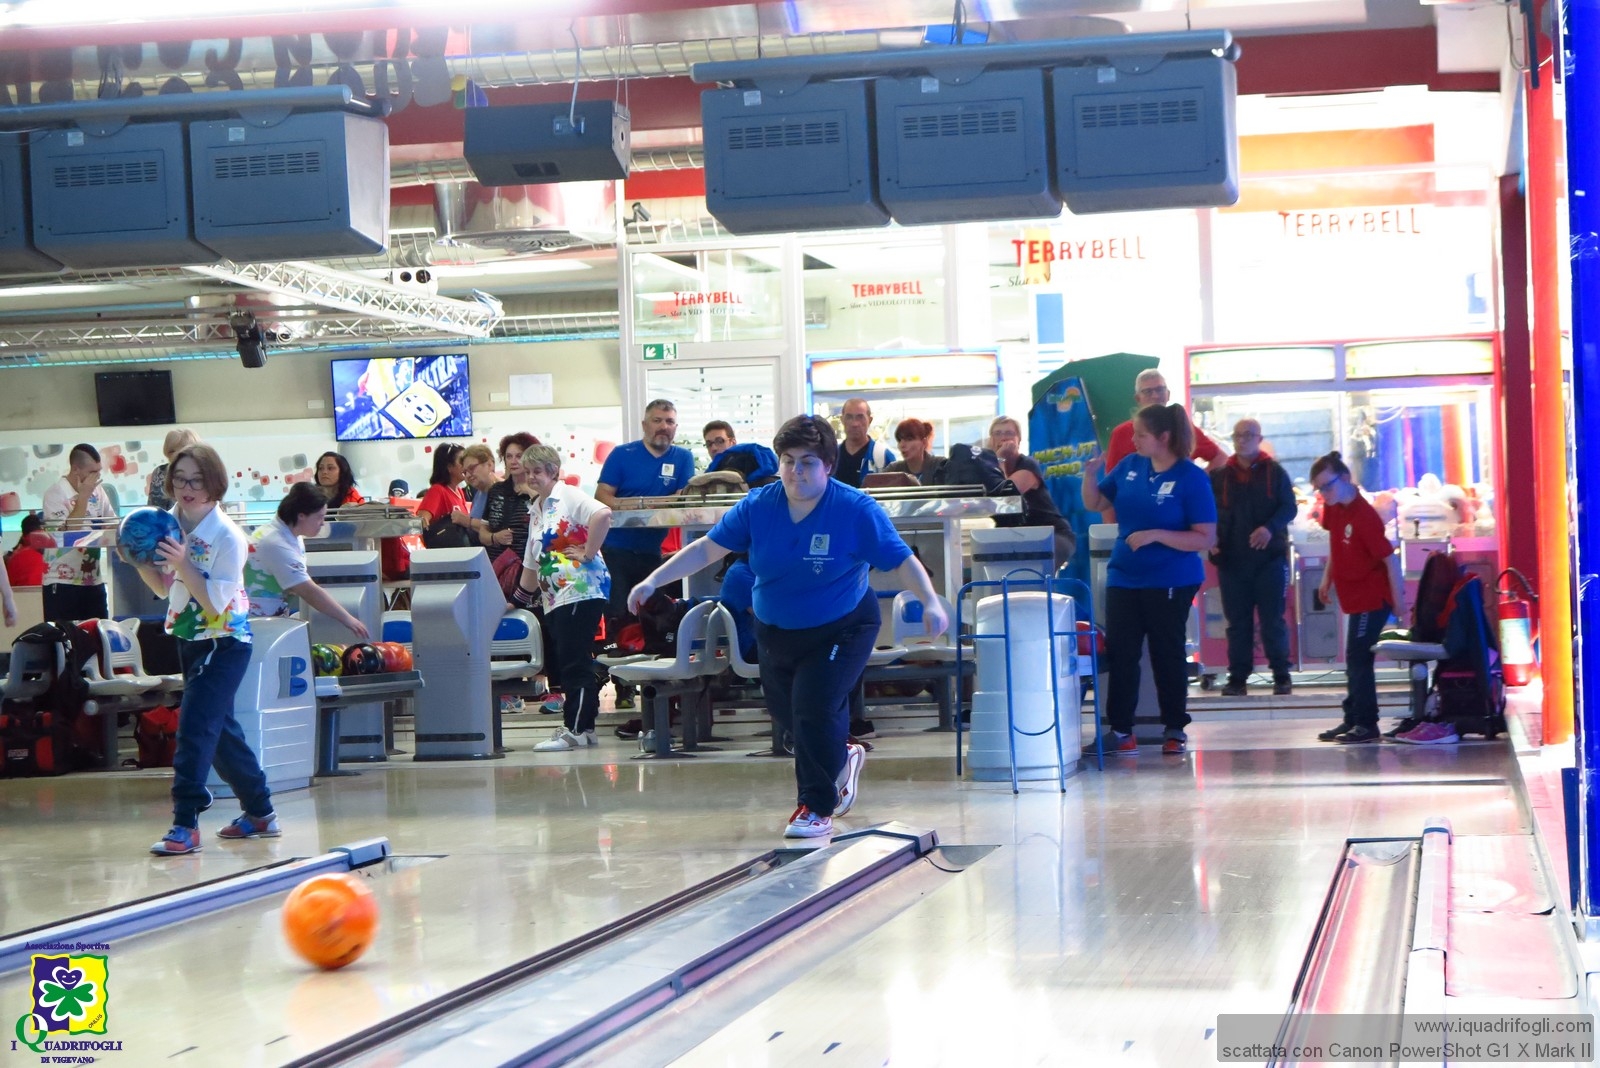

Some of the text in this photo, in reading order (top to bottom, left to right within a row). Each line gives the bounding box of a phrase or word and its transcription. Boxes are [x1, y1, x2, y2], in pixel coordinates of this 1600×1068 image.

[1278, 207, 1421, 237] TERRYBELL
[1011, 236, 1146, 267] TERRYBELL
[673, 290, 743, 307] TERRYBELL
[852, 280, 923, 298] TERRYBELL
[277, 655, 308, 699] B
